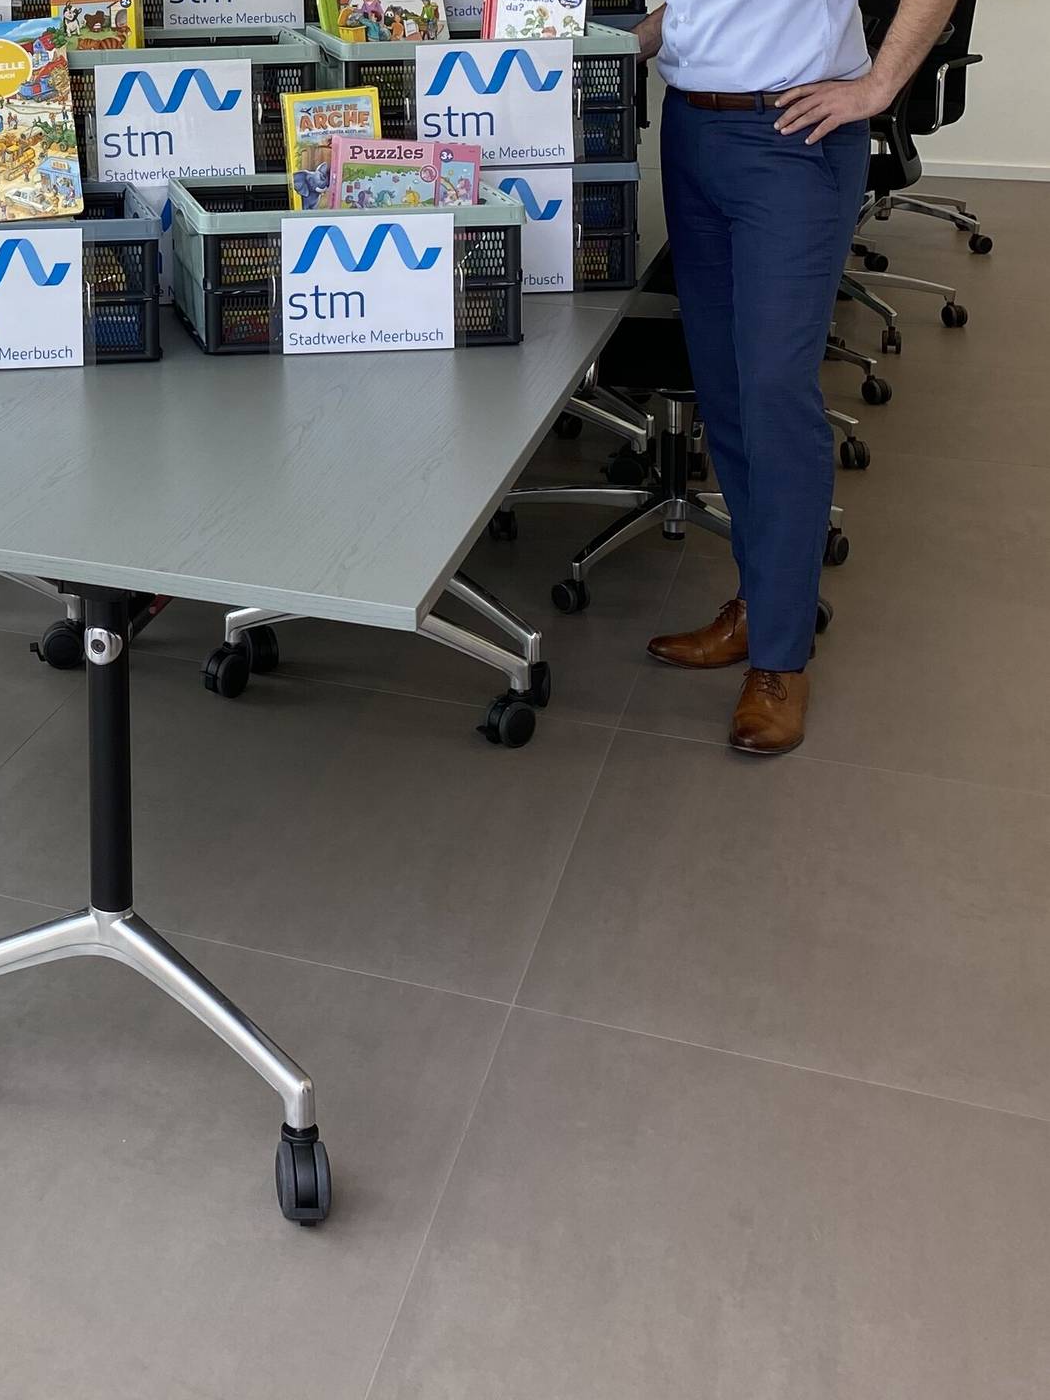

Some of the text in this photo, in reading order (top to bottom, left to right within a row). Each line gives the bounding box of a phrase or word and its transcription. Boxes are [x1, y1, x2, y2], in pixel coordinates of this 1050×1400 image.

[506, 3, 524, 12] da?
[169, 12, 297, 25] Stadtwerke Meerbusch
[299, 111, 370, 132] ARCHE
[424, 106, 494, 138] stm
[104, 125, 173, 158] stm
[350, 146, 424, 160] Puzzles
[440, 151, 453, 160] 3+
[499, 144, 565, 159] Meerbusch
[105, 164, 246, 182] Stadtwerke Meerbusch
[524, 272, 564, 287] rbusch
[289, 285, 365, 320] stm
[289, 328, 444, 346] Stadtwerke Meerbusch
